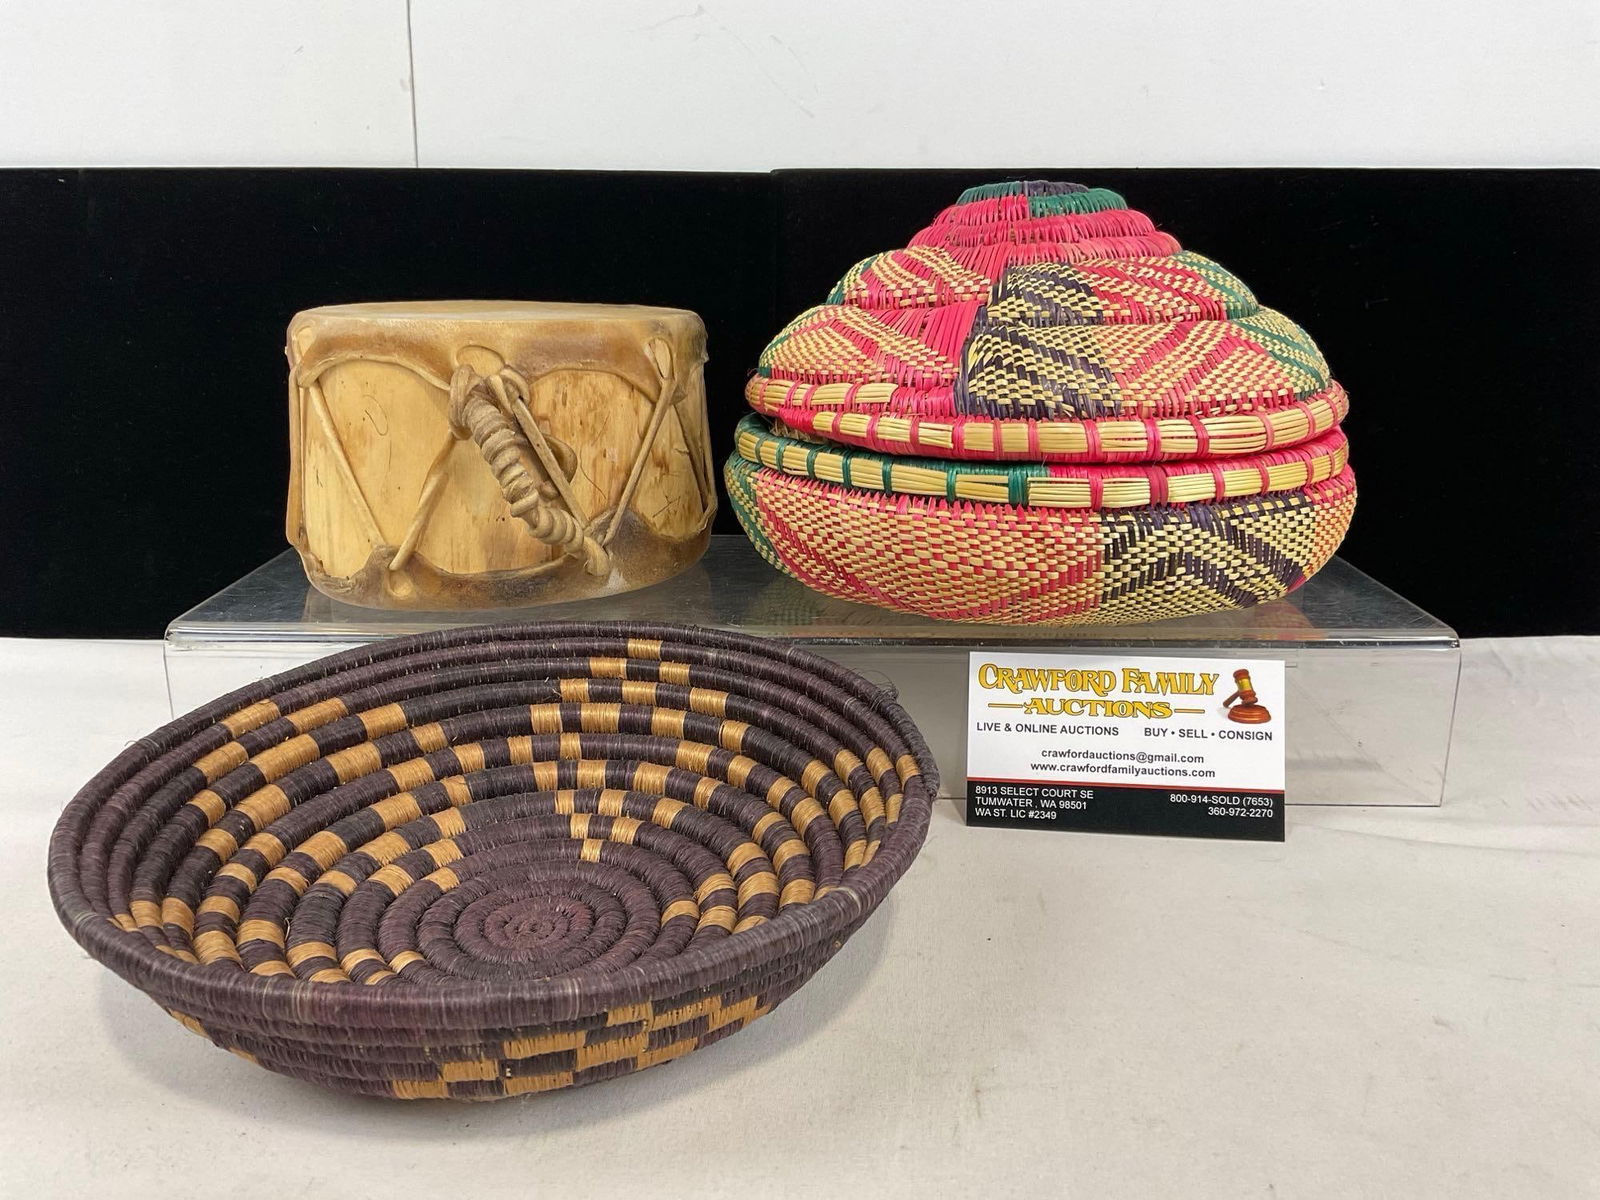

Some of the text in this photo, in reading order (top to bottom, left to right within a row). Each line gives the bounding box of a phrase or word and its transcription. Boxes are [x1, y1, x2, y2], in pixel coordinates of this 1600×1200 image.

[978, 663, 1220, 697] CRAWFORD FAMILY
[1024, 698, 1173, 719] AUCTIONS
[976, 722, 1119, 736] LIVE & ONLINE AUCTIONS
[1144, 728, 1273, 741] BUY SELL CONSIGN
[1041, 749, 1204, 764] crawfordauctions@gmail.com
[1031, 762, 1215, 778] www.crawfordfamilyauctions.com
[975, 786, 1094, 799] 8913 SELECT COURT SE
[1040, 799, 1057, 809] WA
[1059, 800, 1087, 810] 98501
[1170, 794, 1273, 808] 800-914-SOLD (7653)
[976, 808, 993, 817] WA
[1010, 809, 1026, 818] LIC
[1029, 810, 1056, 820] #2349
[1208, 806, 1273, 818] 360-972-2270
